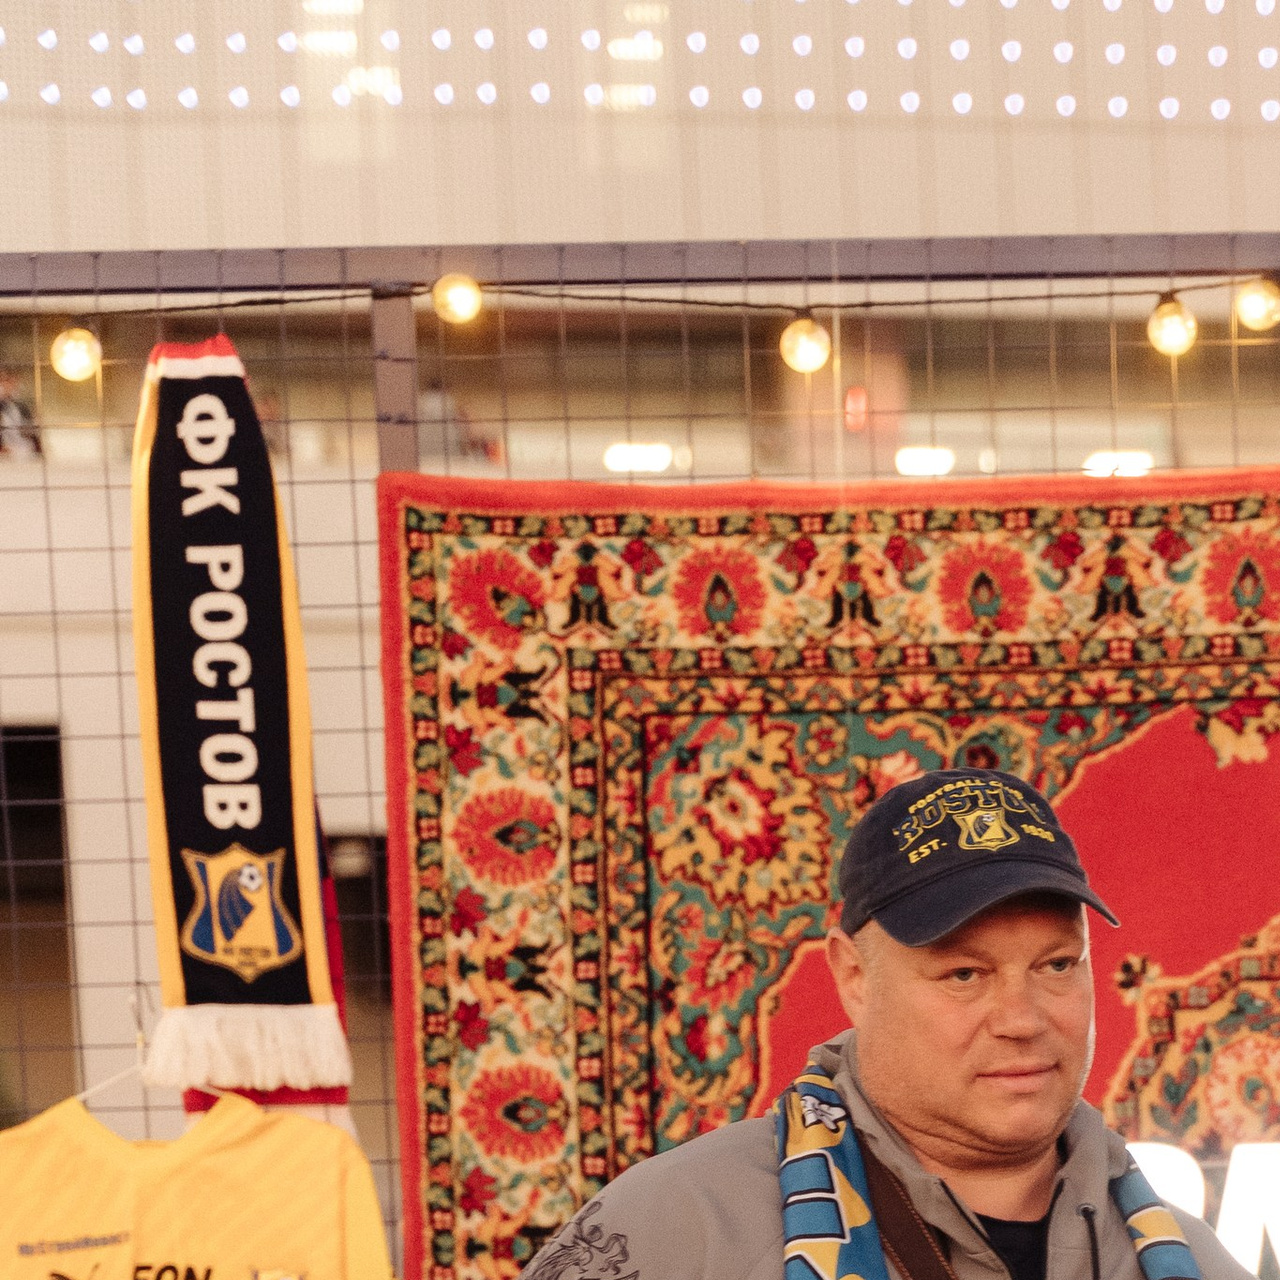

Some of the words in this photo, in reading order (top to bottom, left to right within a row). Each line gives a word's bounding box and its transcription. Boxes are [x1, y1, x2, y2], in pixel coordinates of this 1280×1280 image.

[175, 393, 242, 517] ФК
[184, 543, 263, 831] РОСТОВ
[907, 838, 948, 864] EST.
